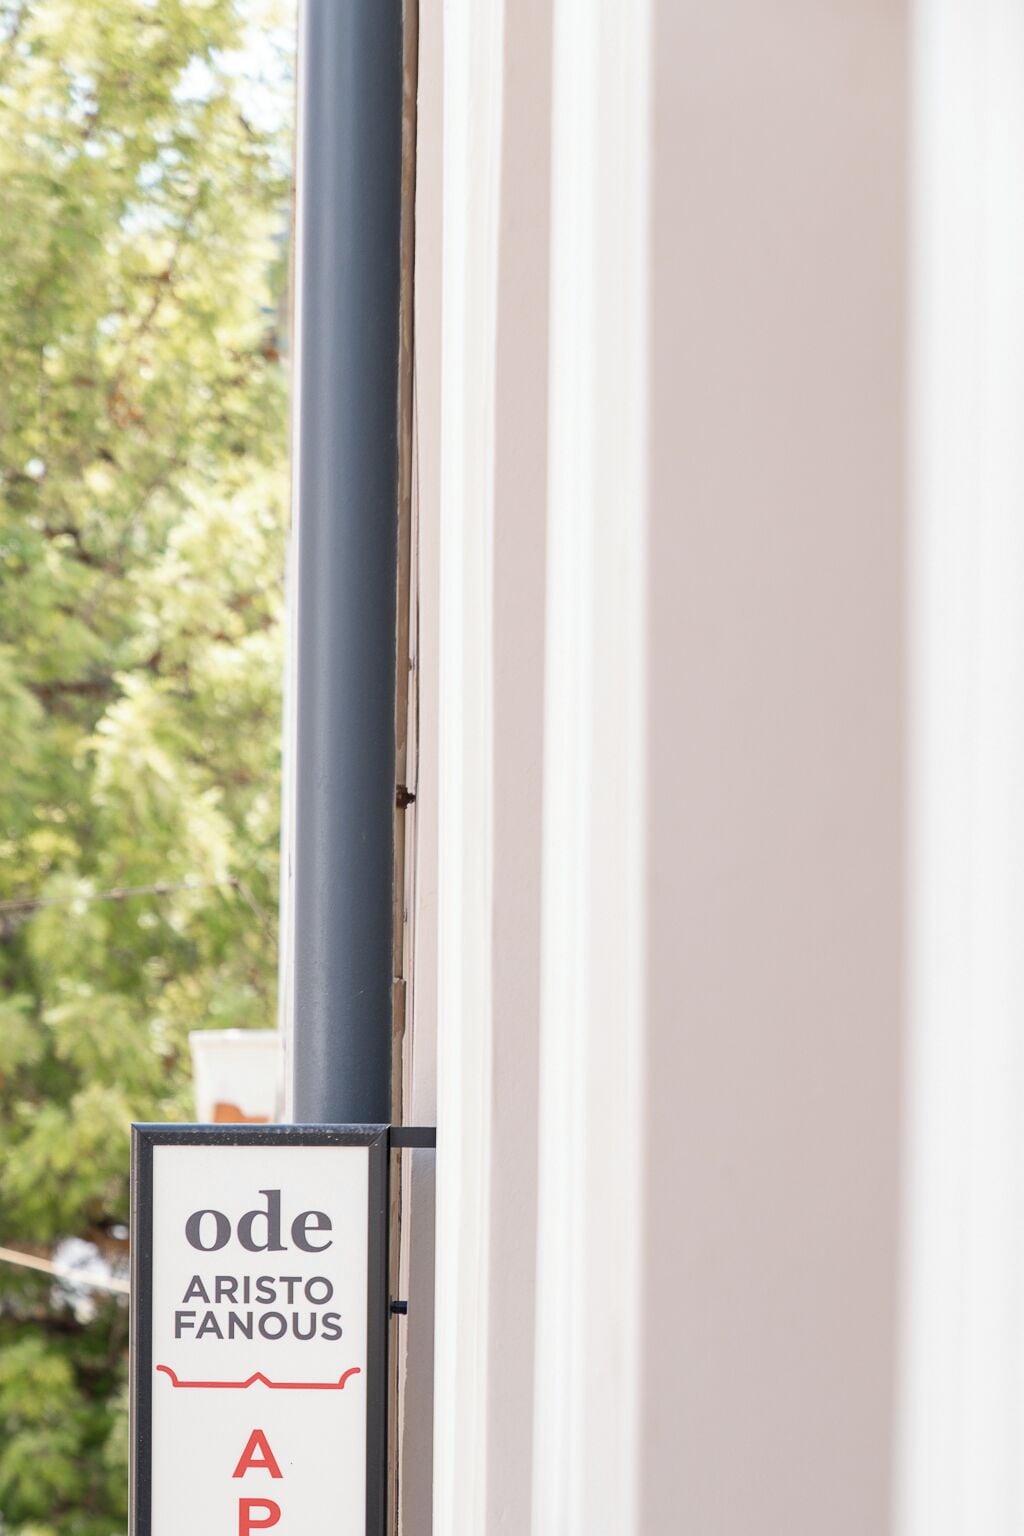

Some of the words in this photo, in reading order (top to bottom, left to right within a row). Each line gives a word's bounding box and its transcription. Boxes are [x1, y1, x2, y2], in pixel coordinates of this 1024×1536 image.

[184, 1189, 333, 1252] ode
[182, 1275, 334, 1305] ARISTO
[174, 1311, 343, 1341] FANOUS
